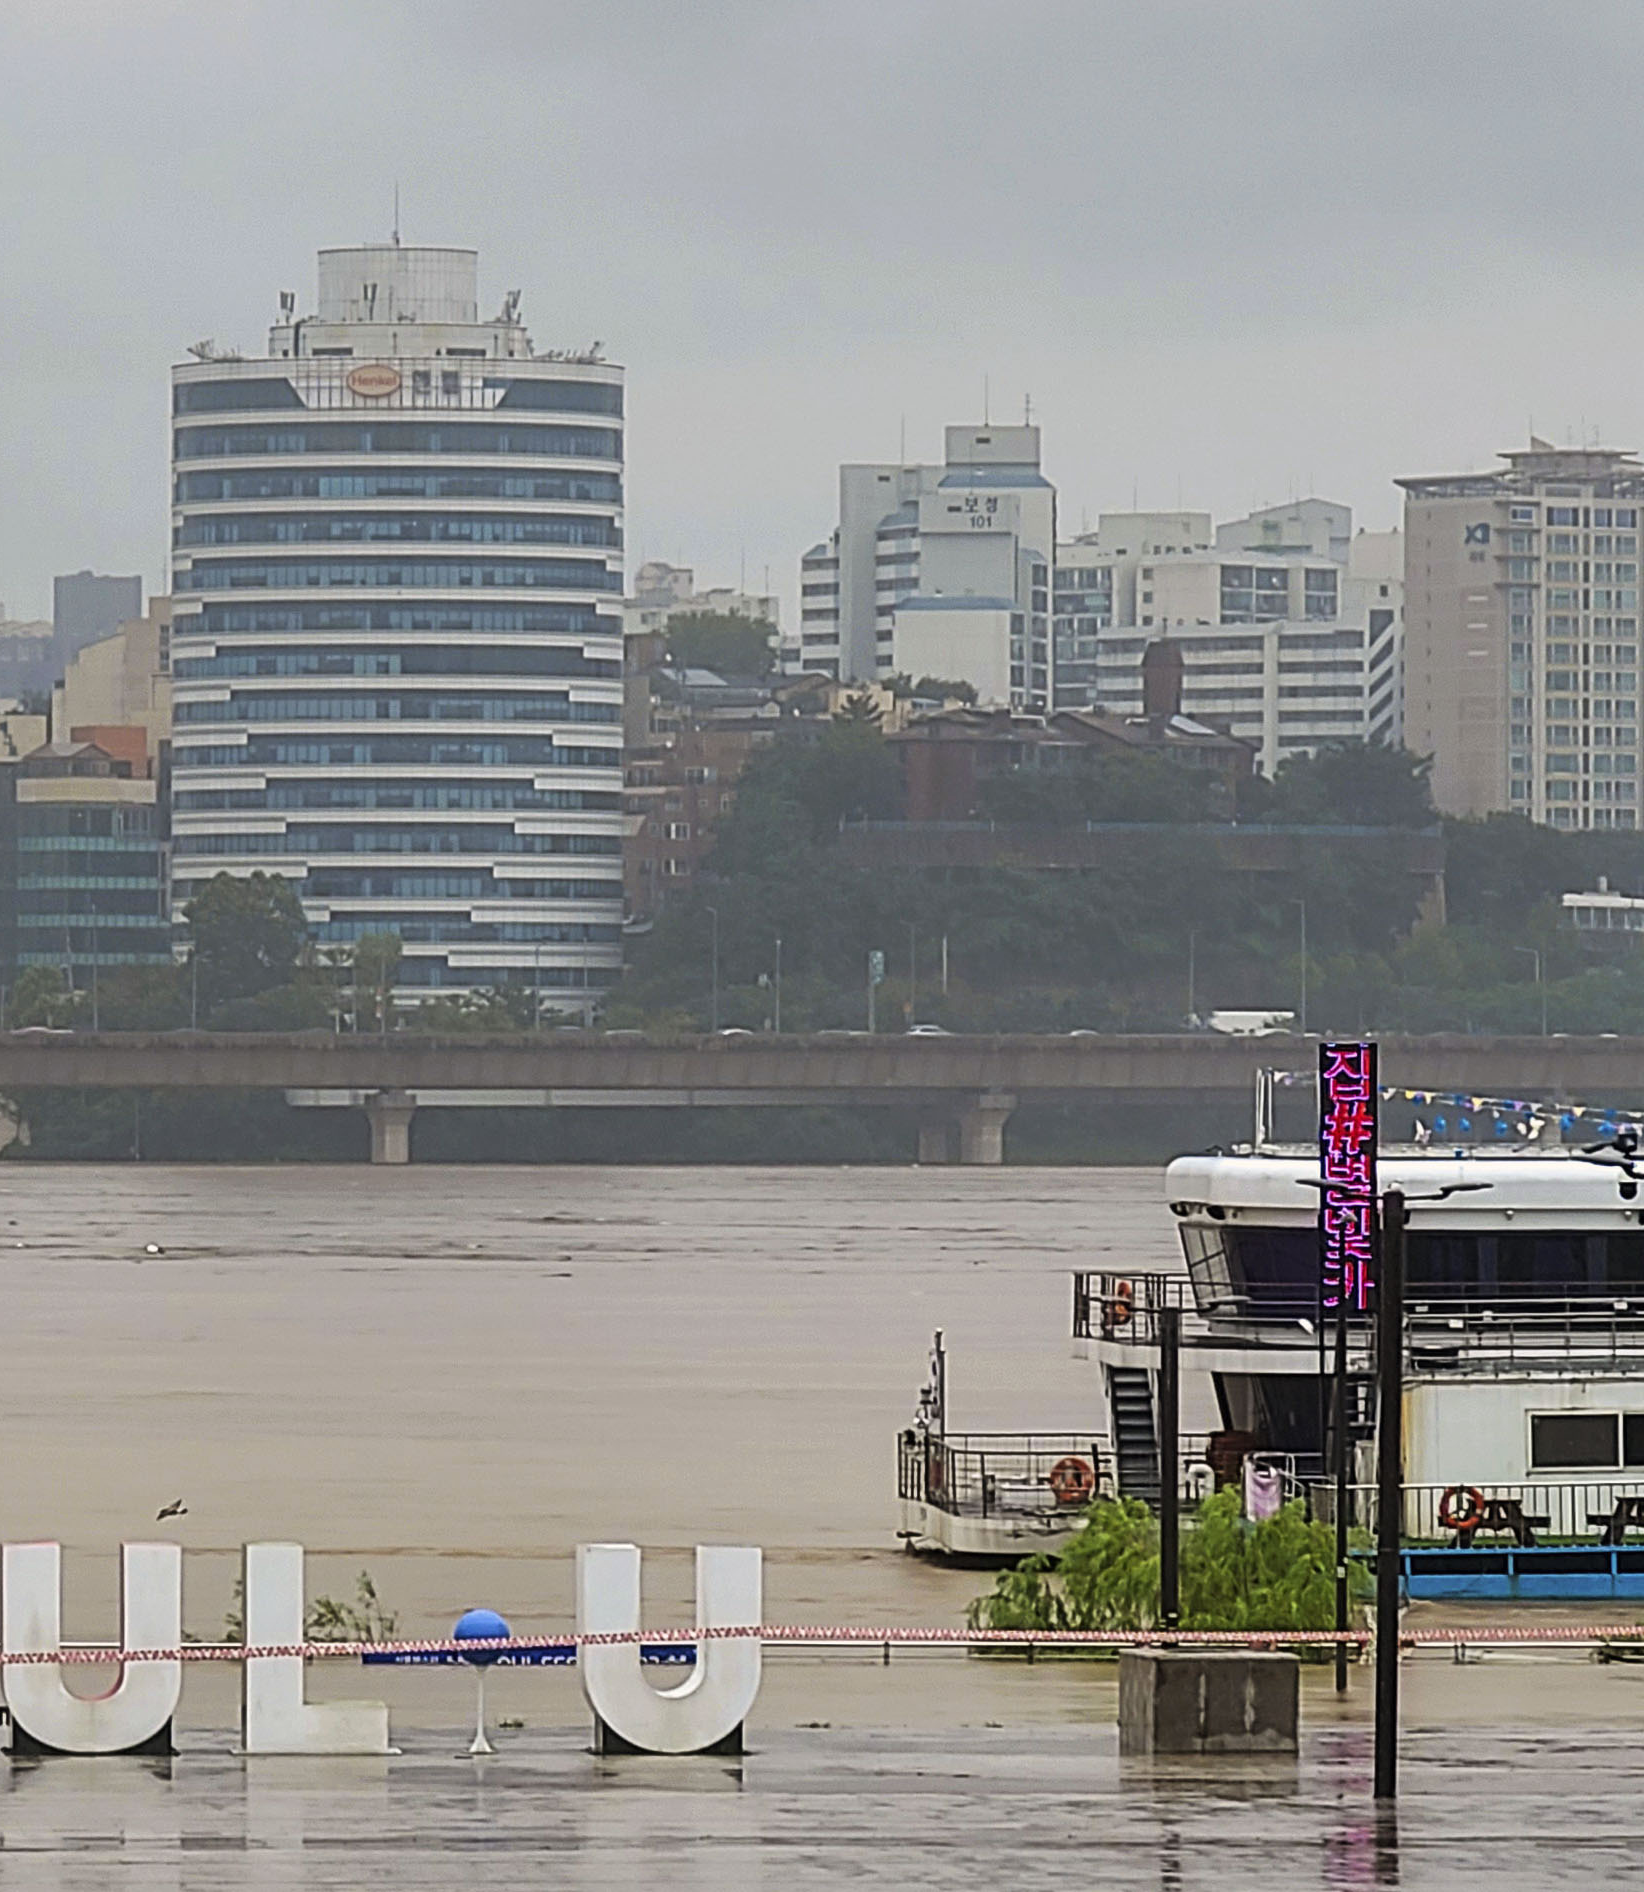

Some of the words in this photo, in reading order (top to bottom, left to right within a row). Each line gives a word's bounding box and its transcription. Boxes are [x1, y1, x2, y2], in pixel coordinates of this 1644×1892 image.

[352, 374, 398, 387] Henkel
[970, 515, 992, 528] 101
[576, 1543, 762, 1755] U
